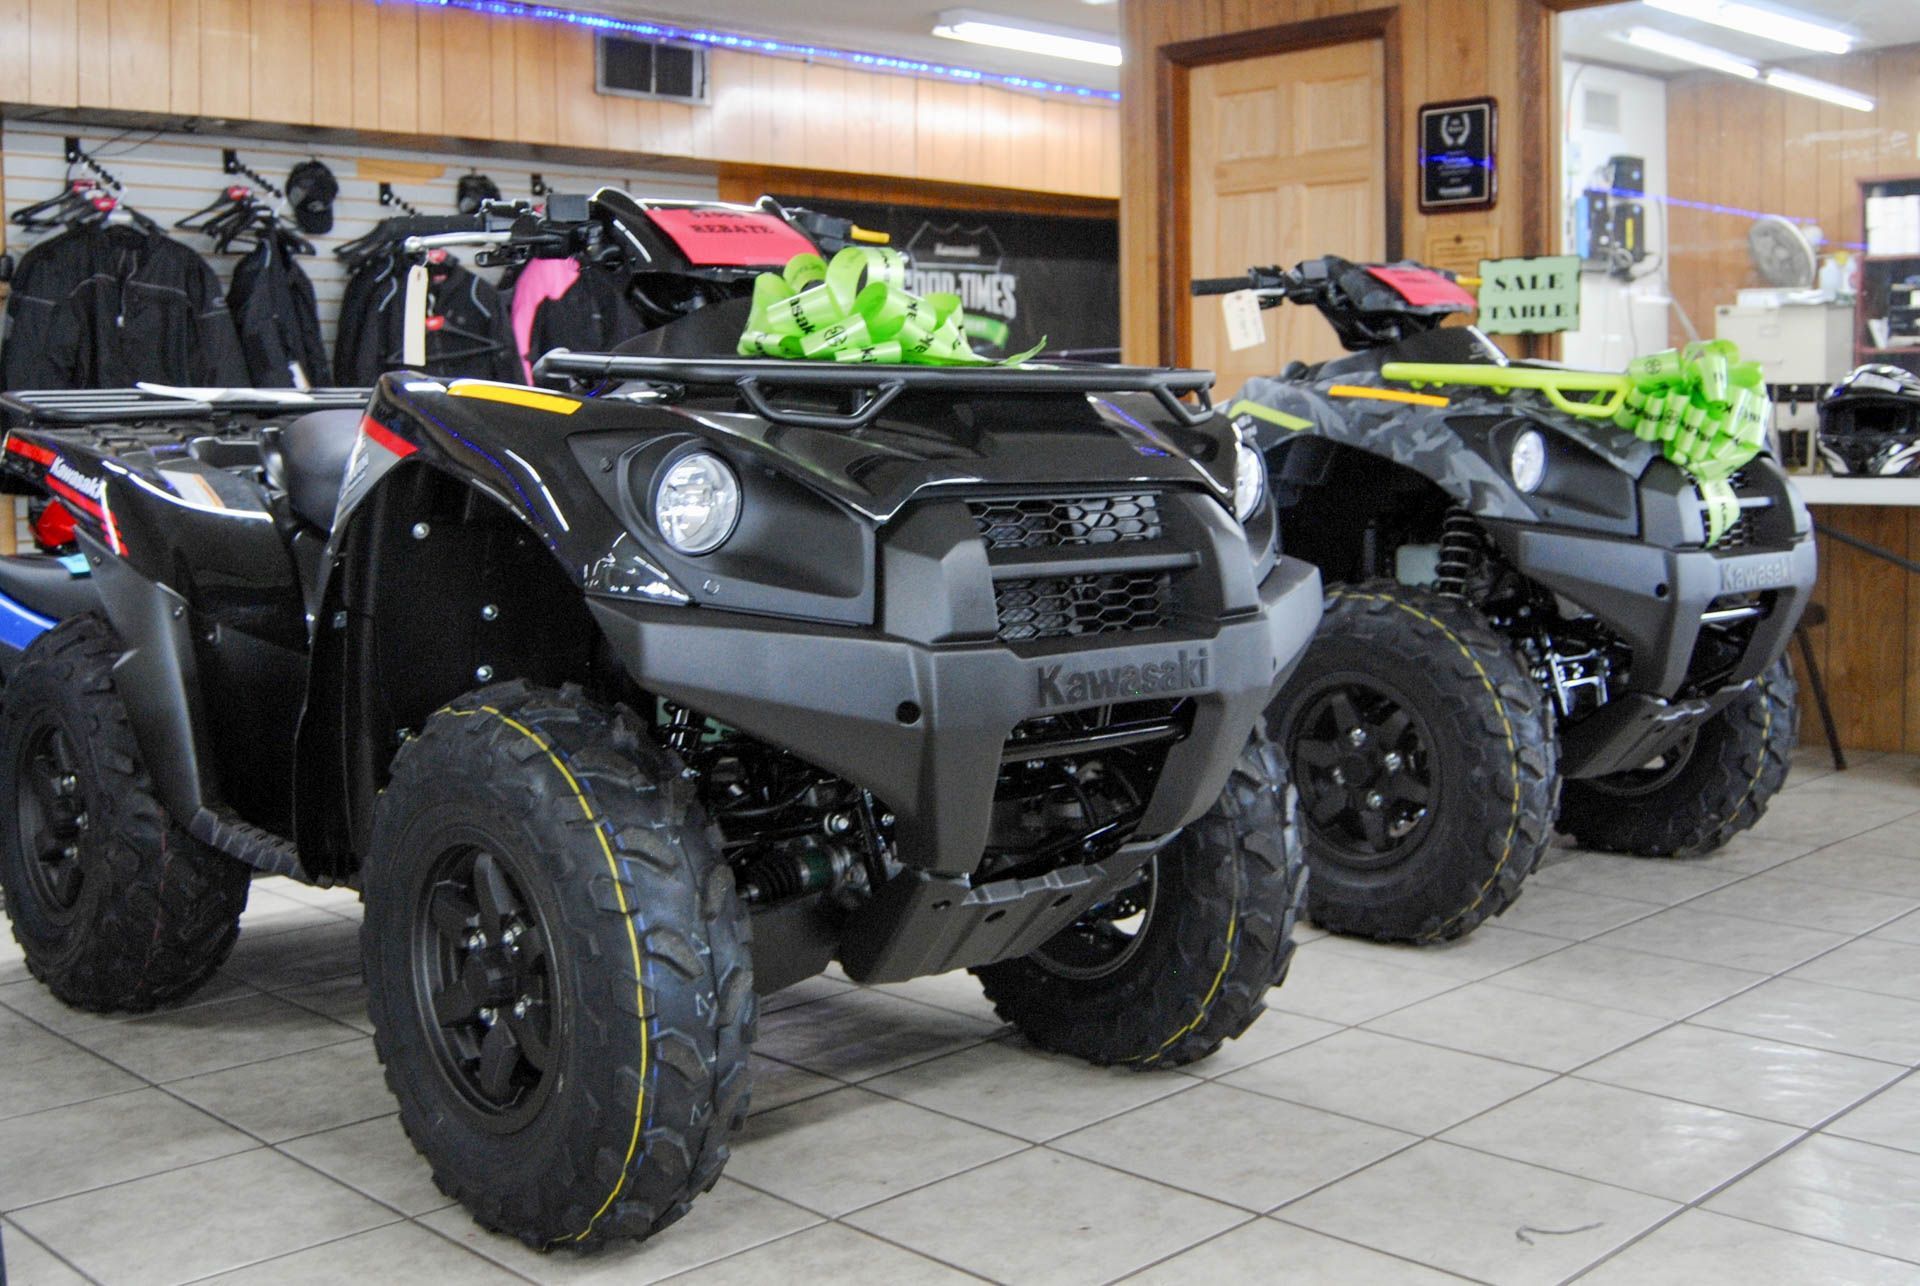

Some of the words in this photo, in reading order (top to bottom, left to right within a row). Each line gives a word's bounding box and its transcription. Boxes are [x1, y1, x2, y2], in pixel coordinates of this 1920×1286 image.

[689, 223, 775, 234] REBATE
[959, 272, 1017, 320] TIMES
[1493, 273, 1564, 293] SALE
[1487, 303, 1568, 319] TABLE
[49, 455, 106, 500] Kawasaki
[1720, 556, 1793, 592] Kawasaki
[1038, 648, 1209, 708] Kawasaki
